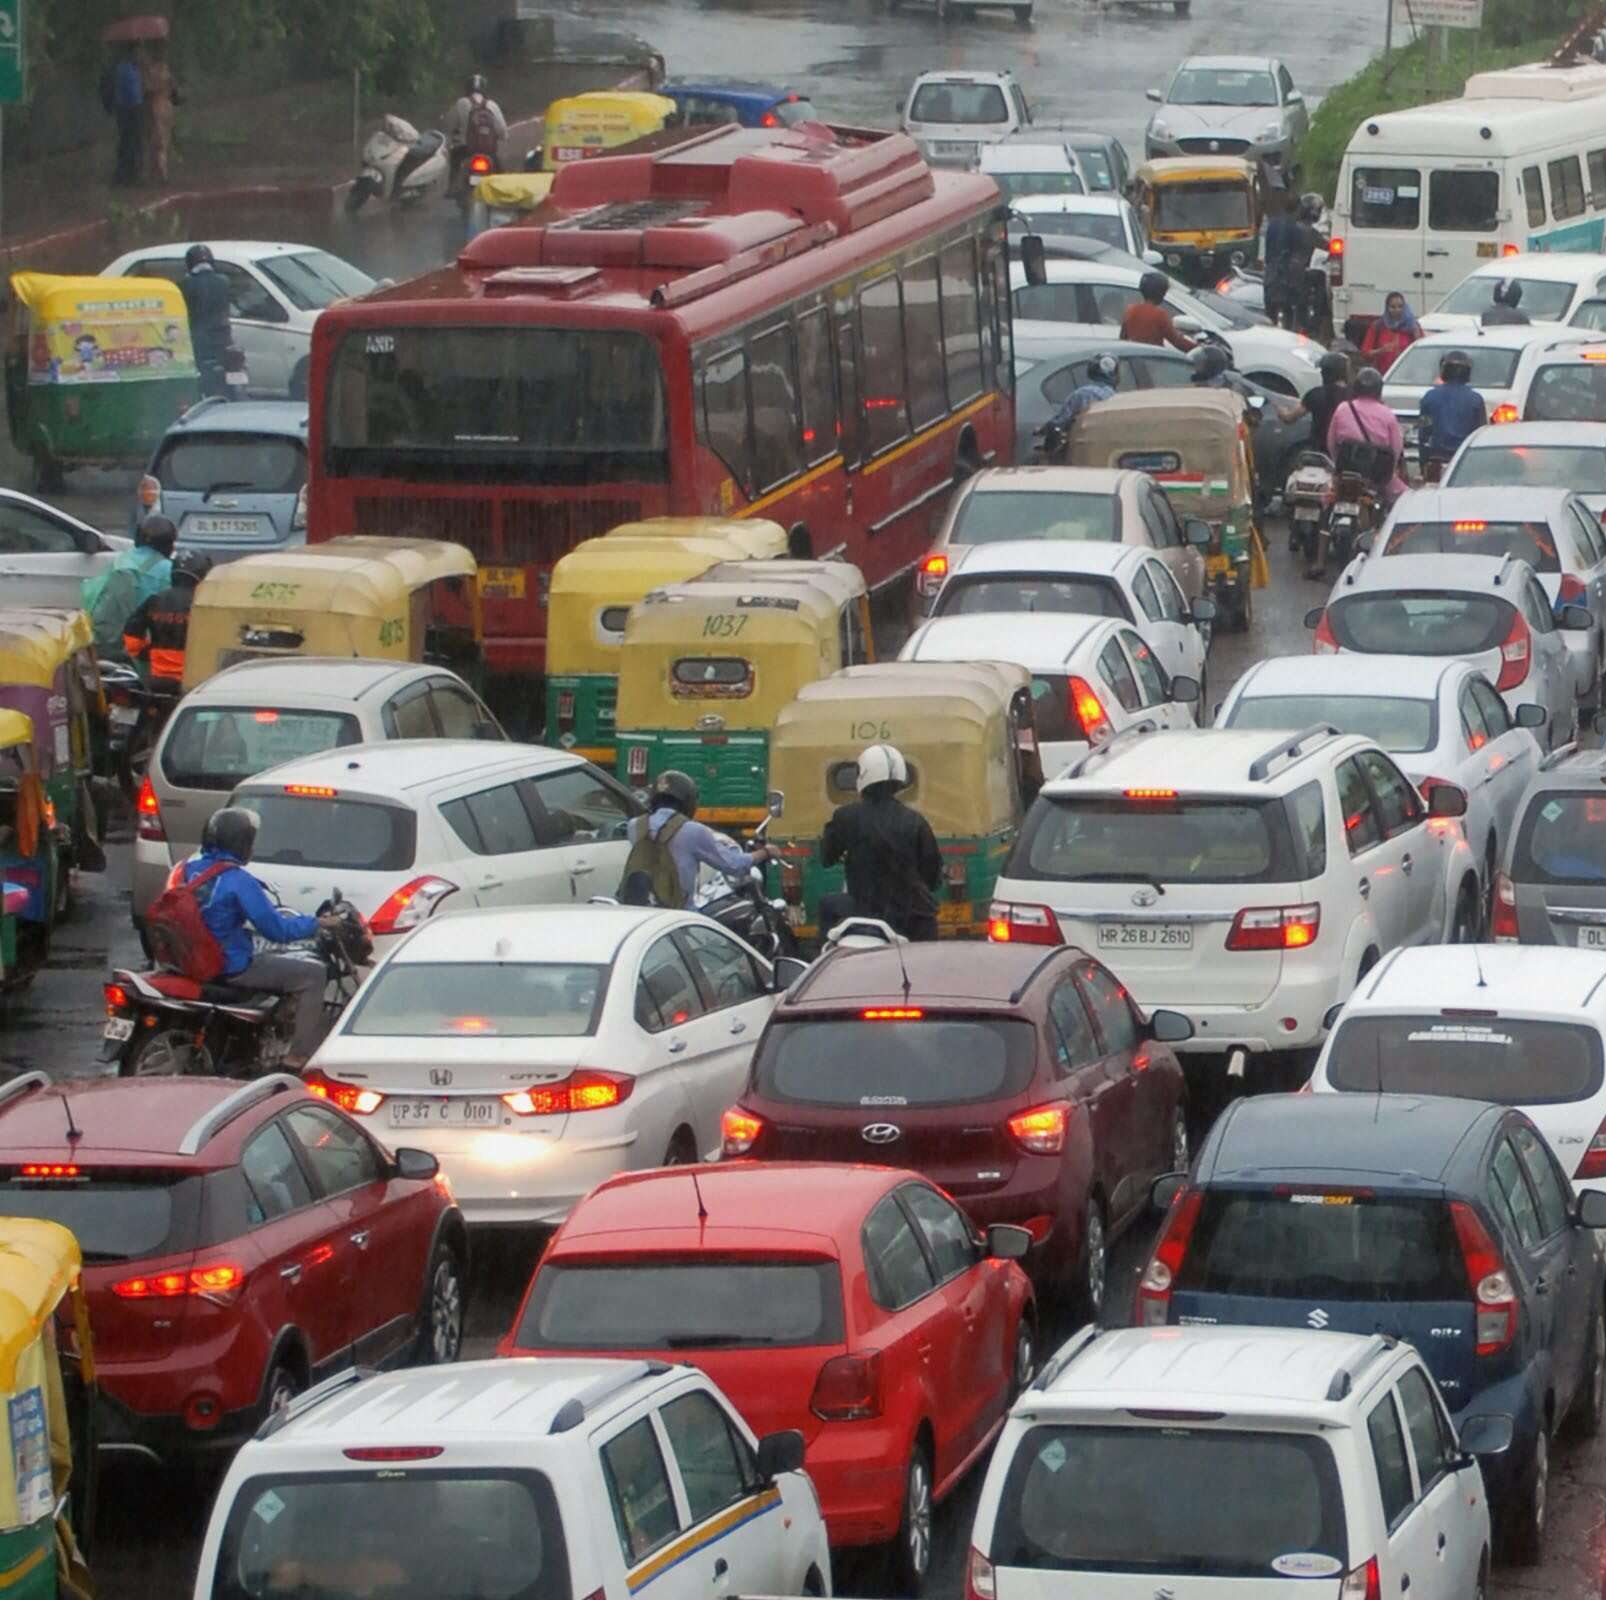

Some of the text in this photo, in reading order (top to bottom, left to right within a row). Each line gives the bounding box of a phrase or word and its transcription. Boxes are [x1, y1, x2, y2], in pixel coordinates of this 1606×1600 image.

[703, 614, 747, 638] 1037
[1101, 929, 1191, 944] HR 26 BJ 2610
[392, 1102, 493, 1120] UP 37 C 0101
